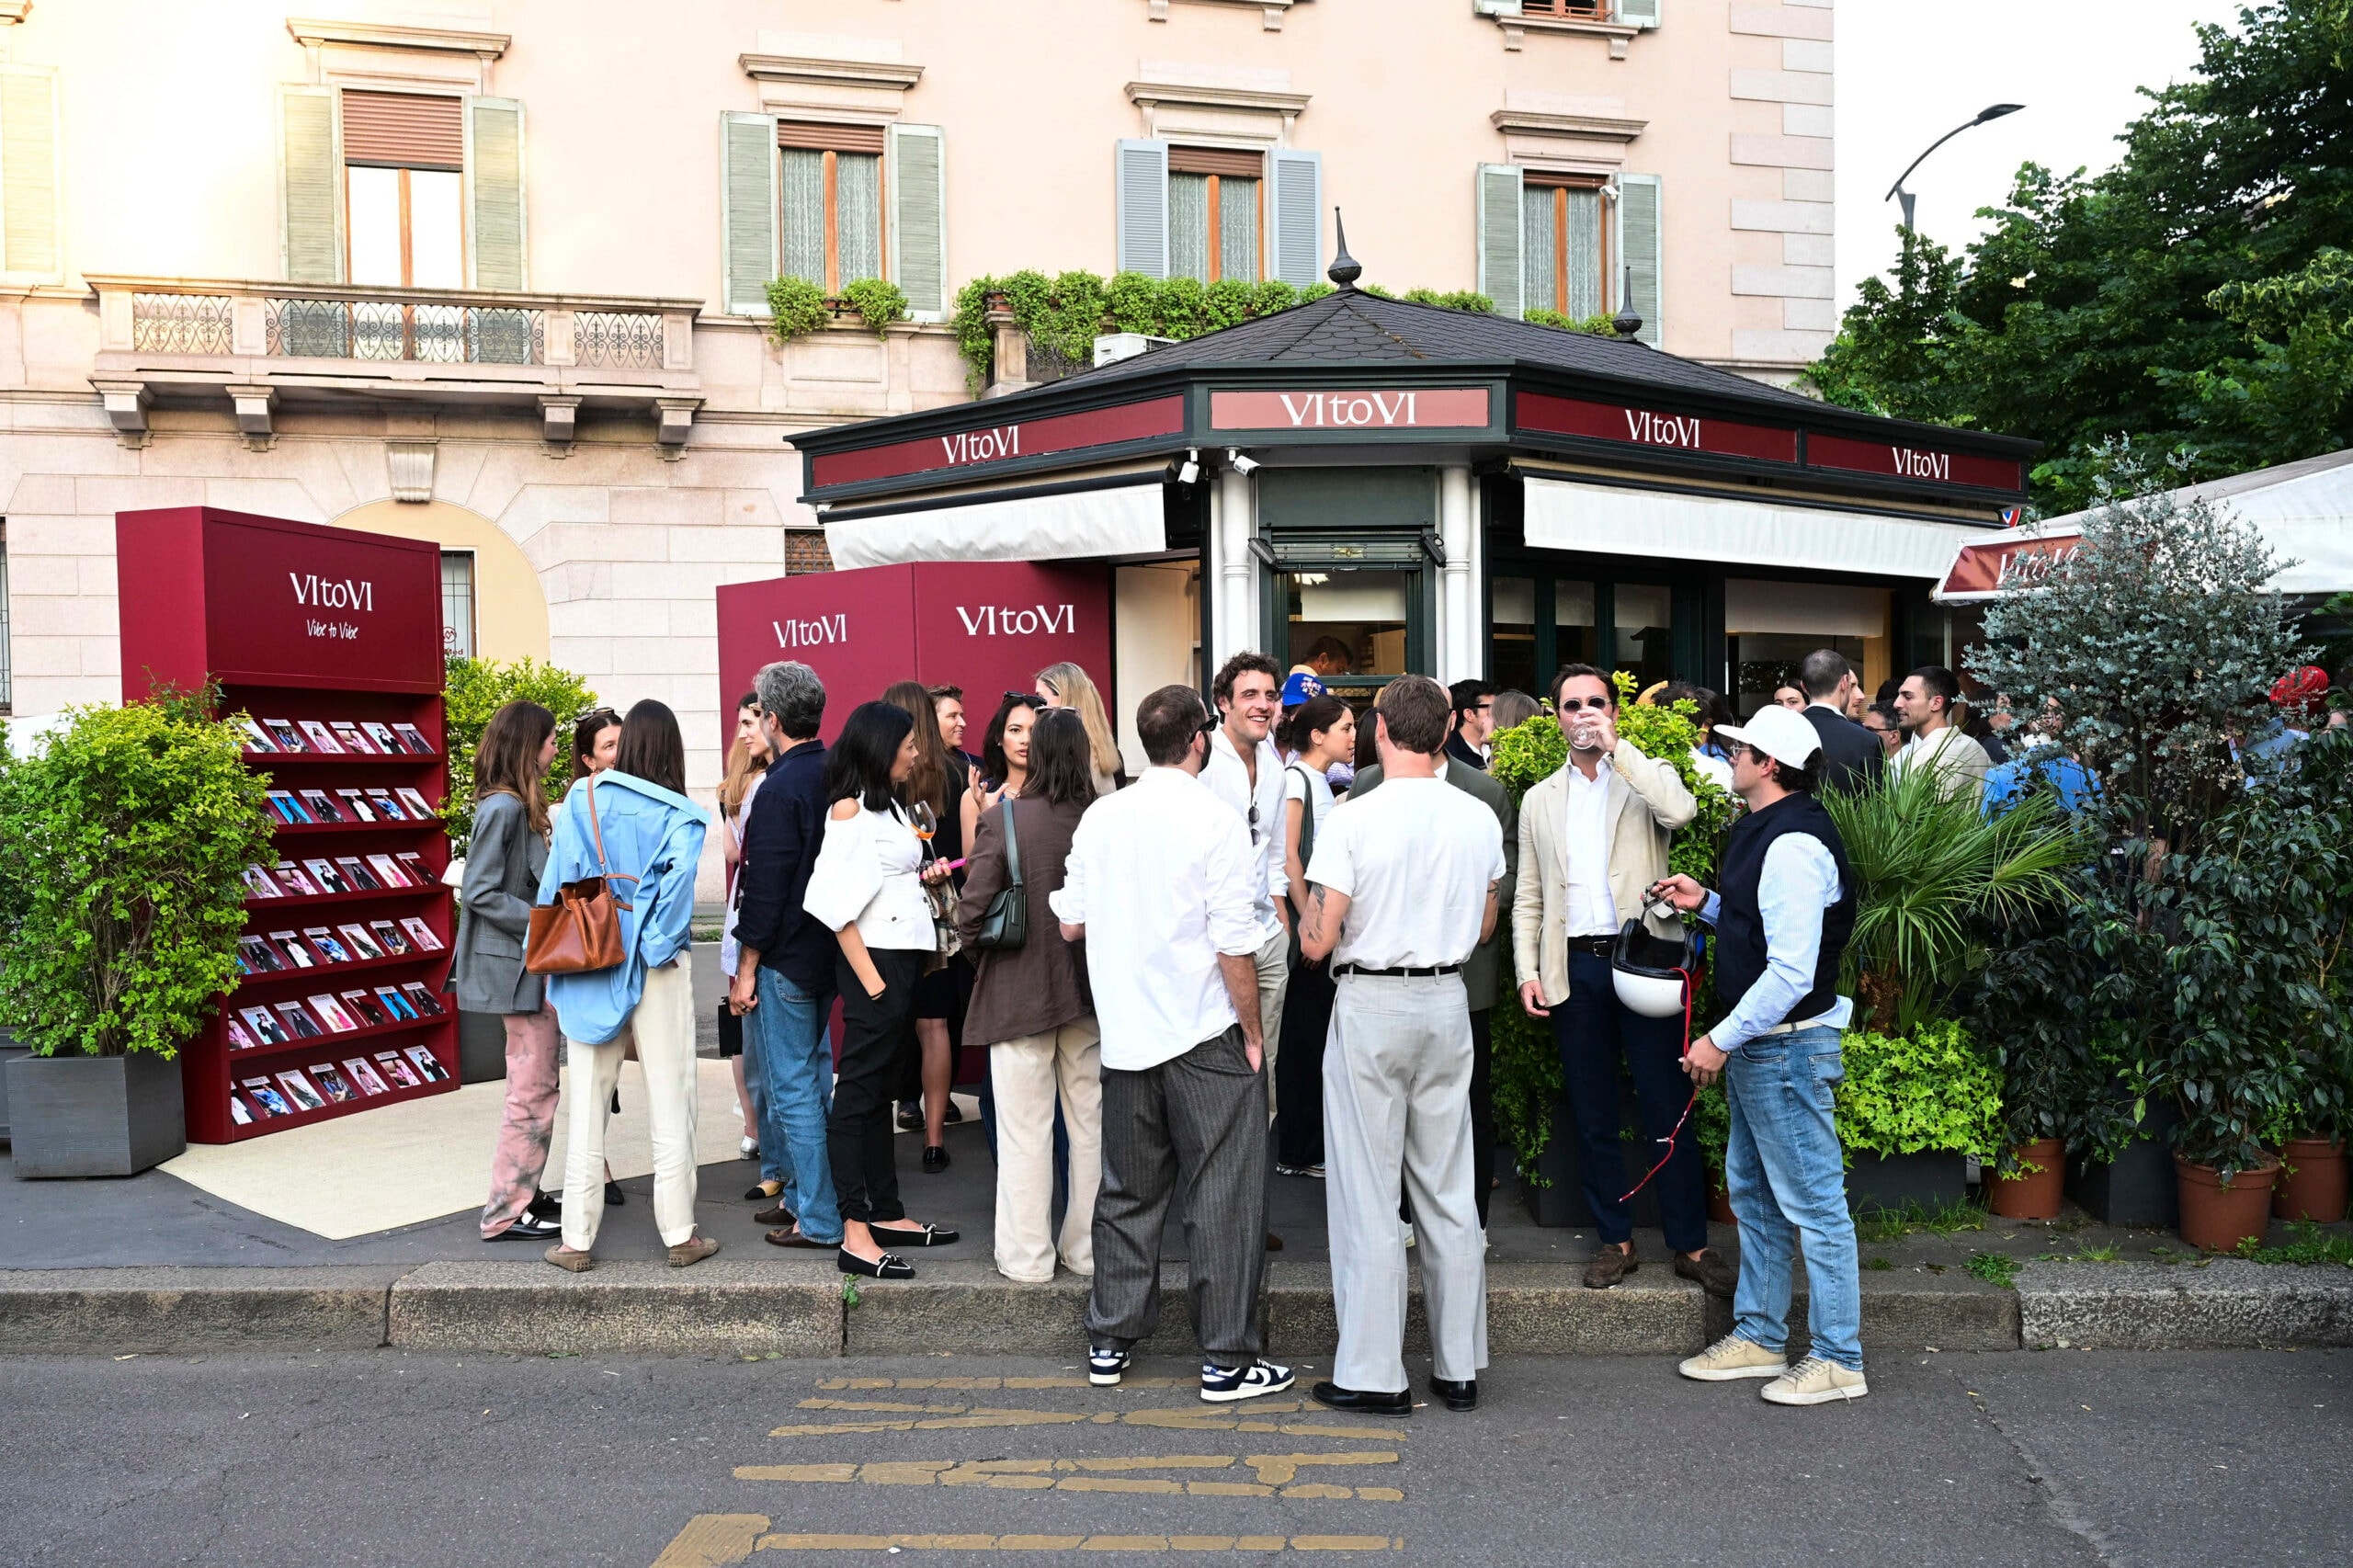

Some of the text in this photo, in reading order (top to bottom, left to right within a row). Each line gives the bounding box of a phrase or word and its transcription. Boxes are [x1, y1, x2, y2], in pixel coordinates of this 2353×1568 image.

[1279, 392, 1416, 426] VItoVI
[941, 425, 1019, 464] VItoVI
[1624, 409, 1700, 449] VItoVI
[1892, 447, 1949, 480] VItoVI
[289, 572, 372, 612] VItoVI
[306, 618, 359, 641] Vibe to Vibe
[772, 613, 847, 649] VItoVI
[956, 604, 1075, 636] VItoVI
